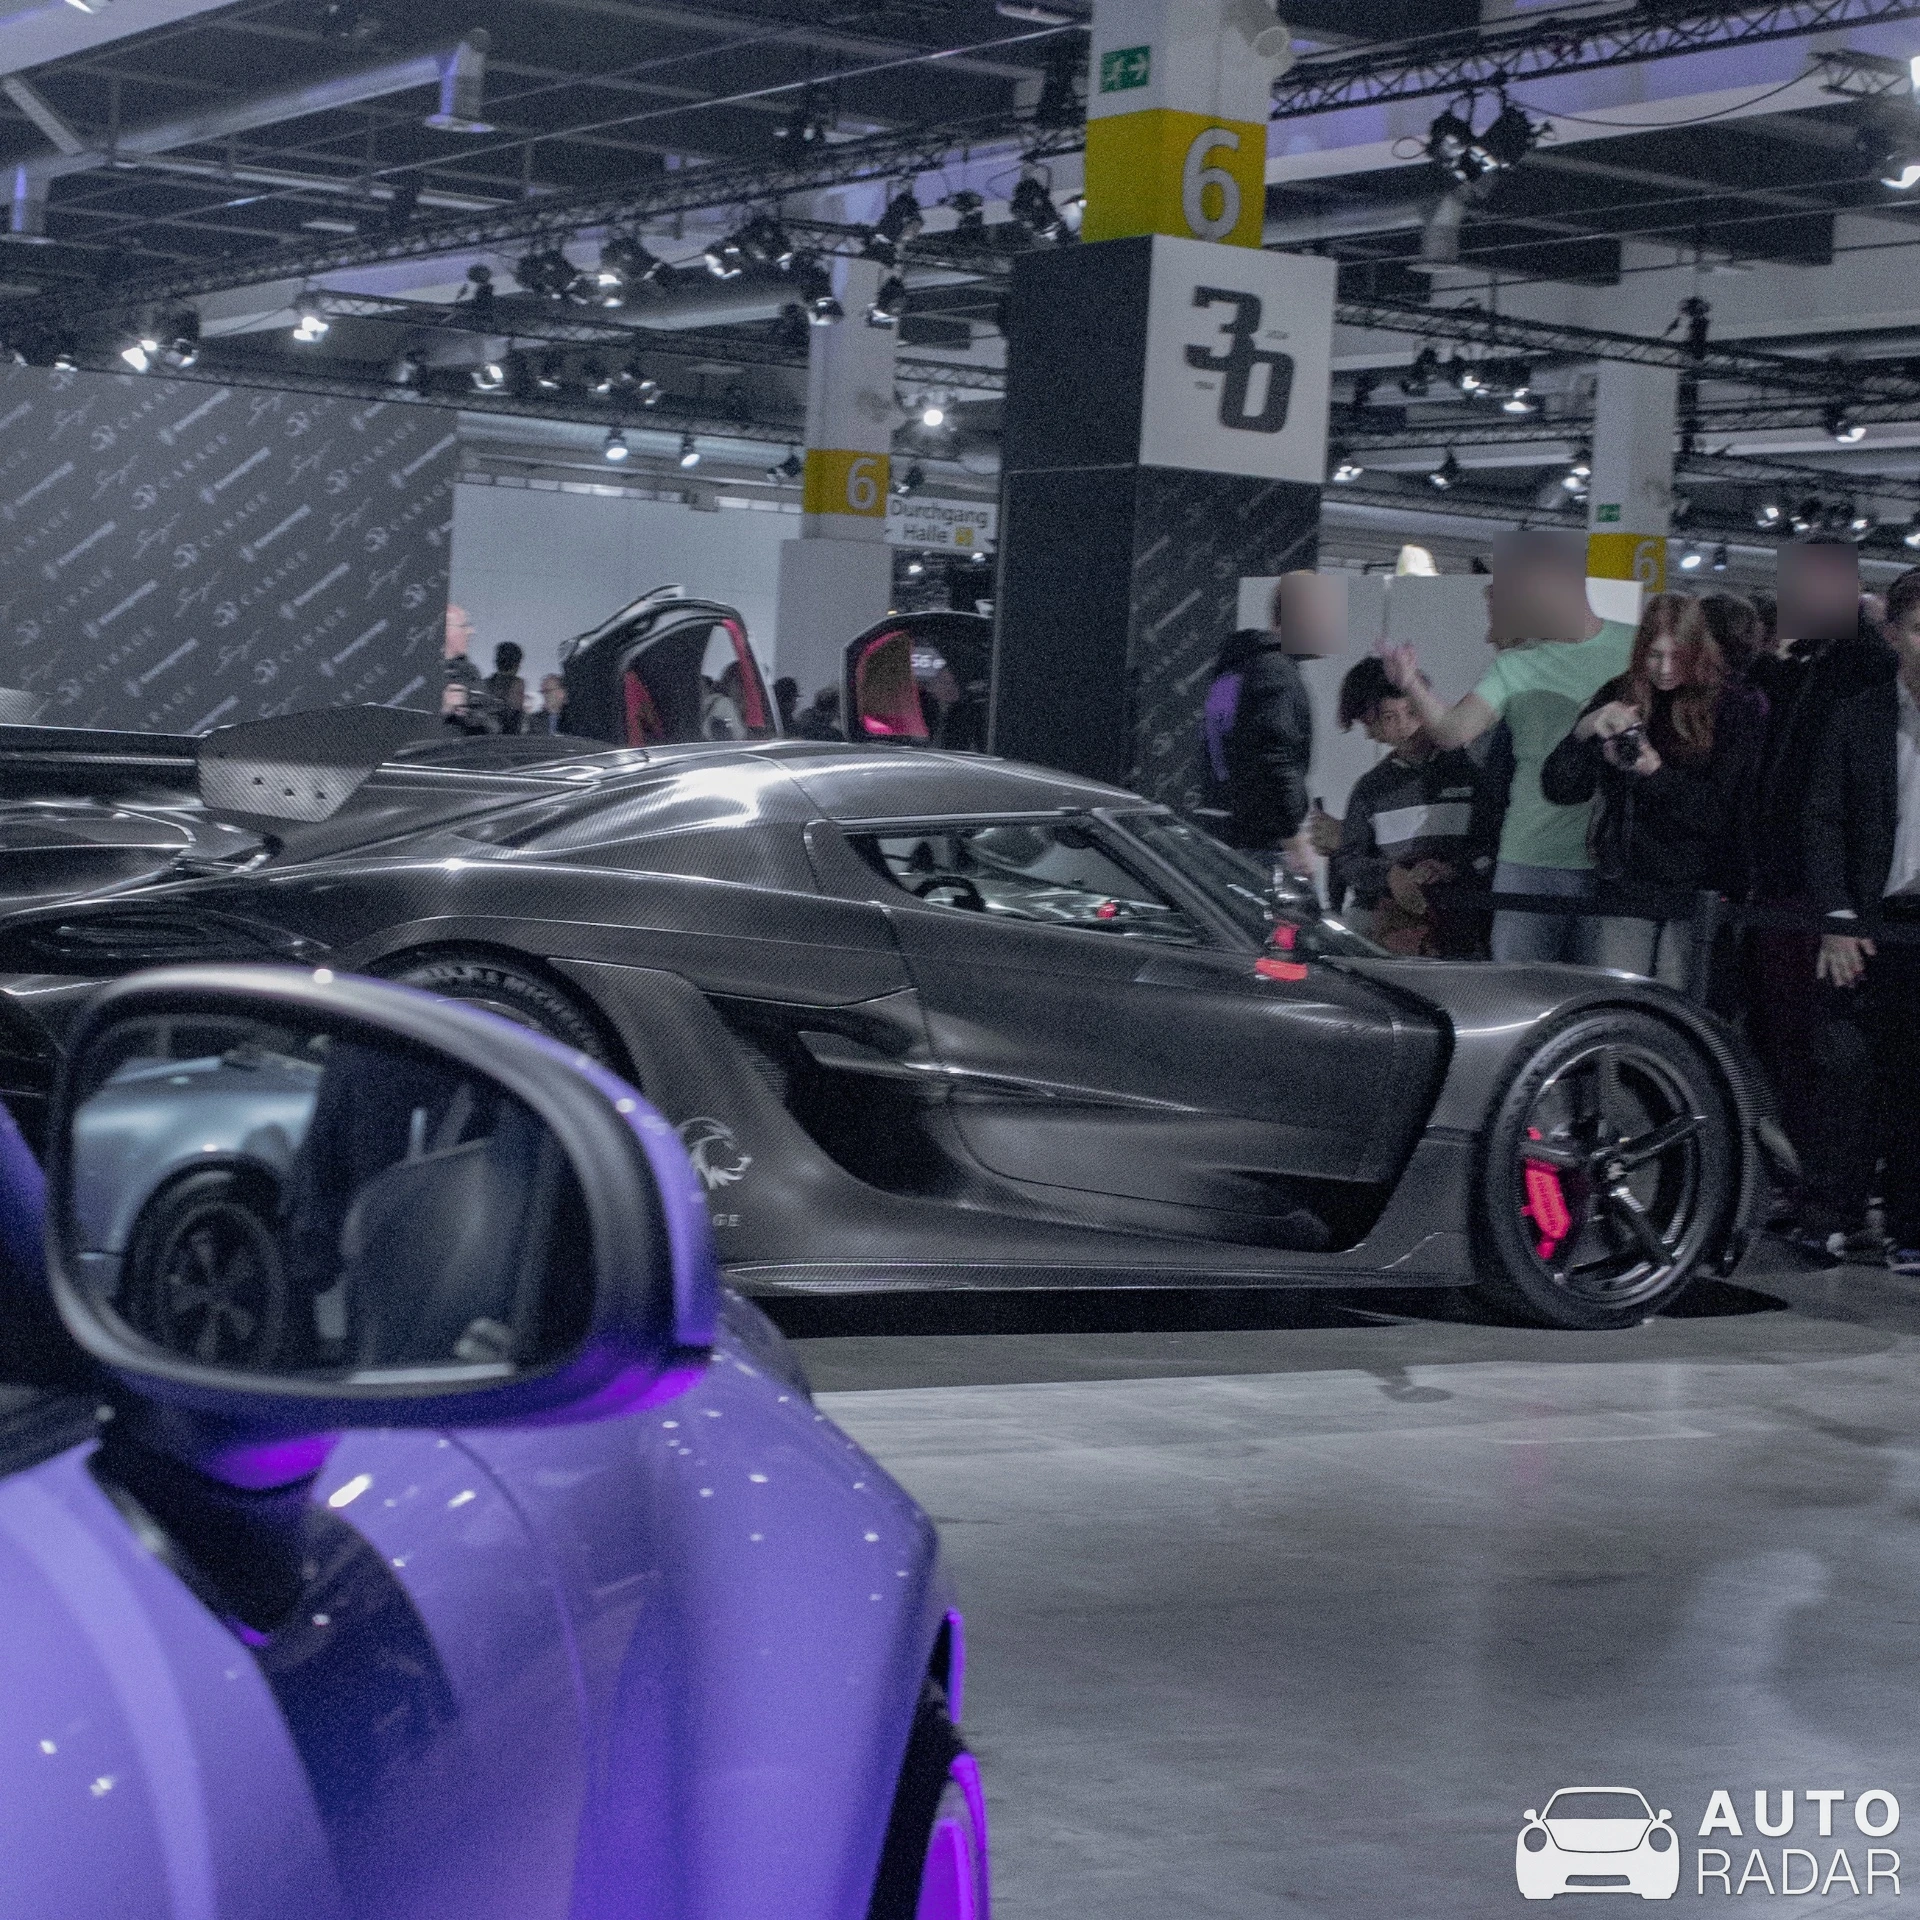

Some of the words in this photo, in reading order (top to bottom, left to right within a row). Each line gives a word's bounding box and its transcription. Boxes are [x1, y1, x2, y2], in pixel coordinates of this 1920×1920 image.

[1182, 127, 1241, 242] 6
[846, 456, 878, 511] 6
[890, 499, 988, 529] Durchgang
[903, 523, 948, 544] Halle
[1633, 541, 1659, 587] 6
[712, 1213, 742, 1227] GE
